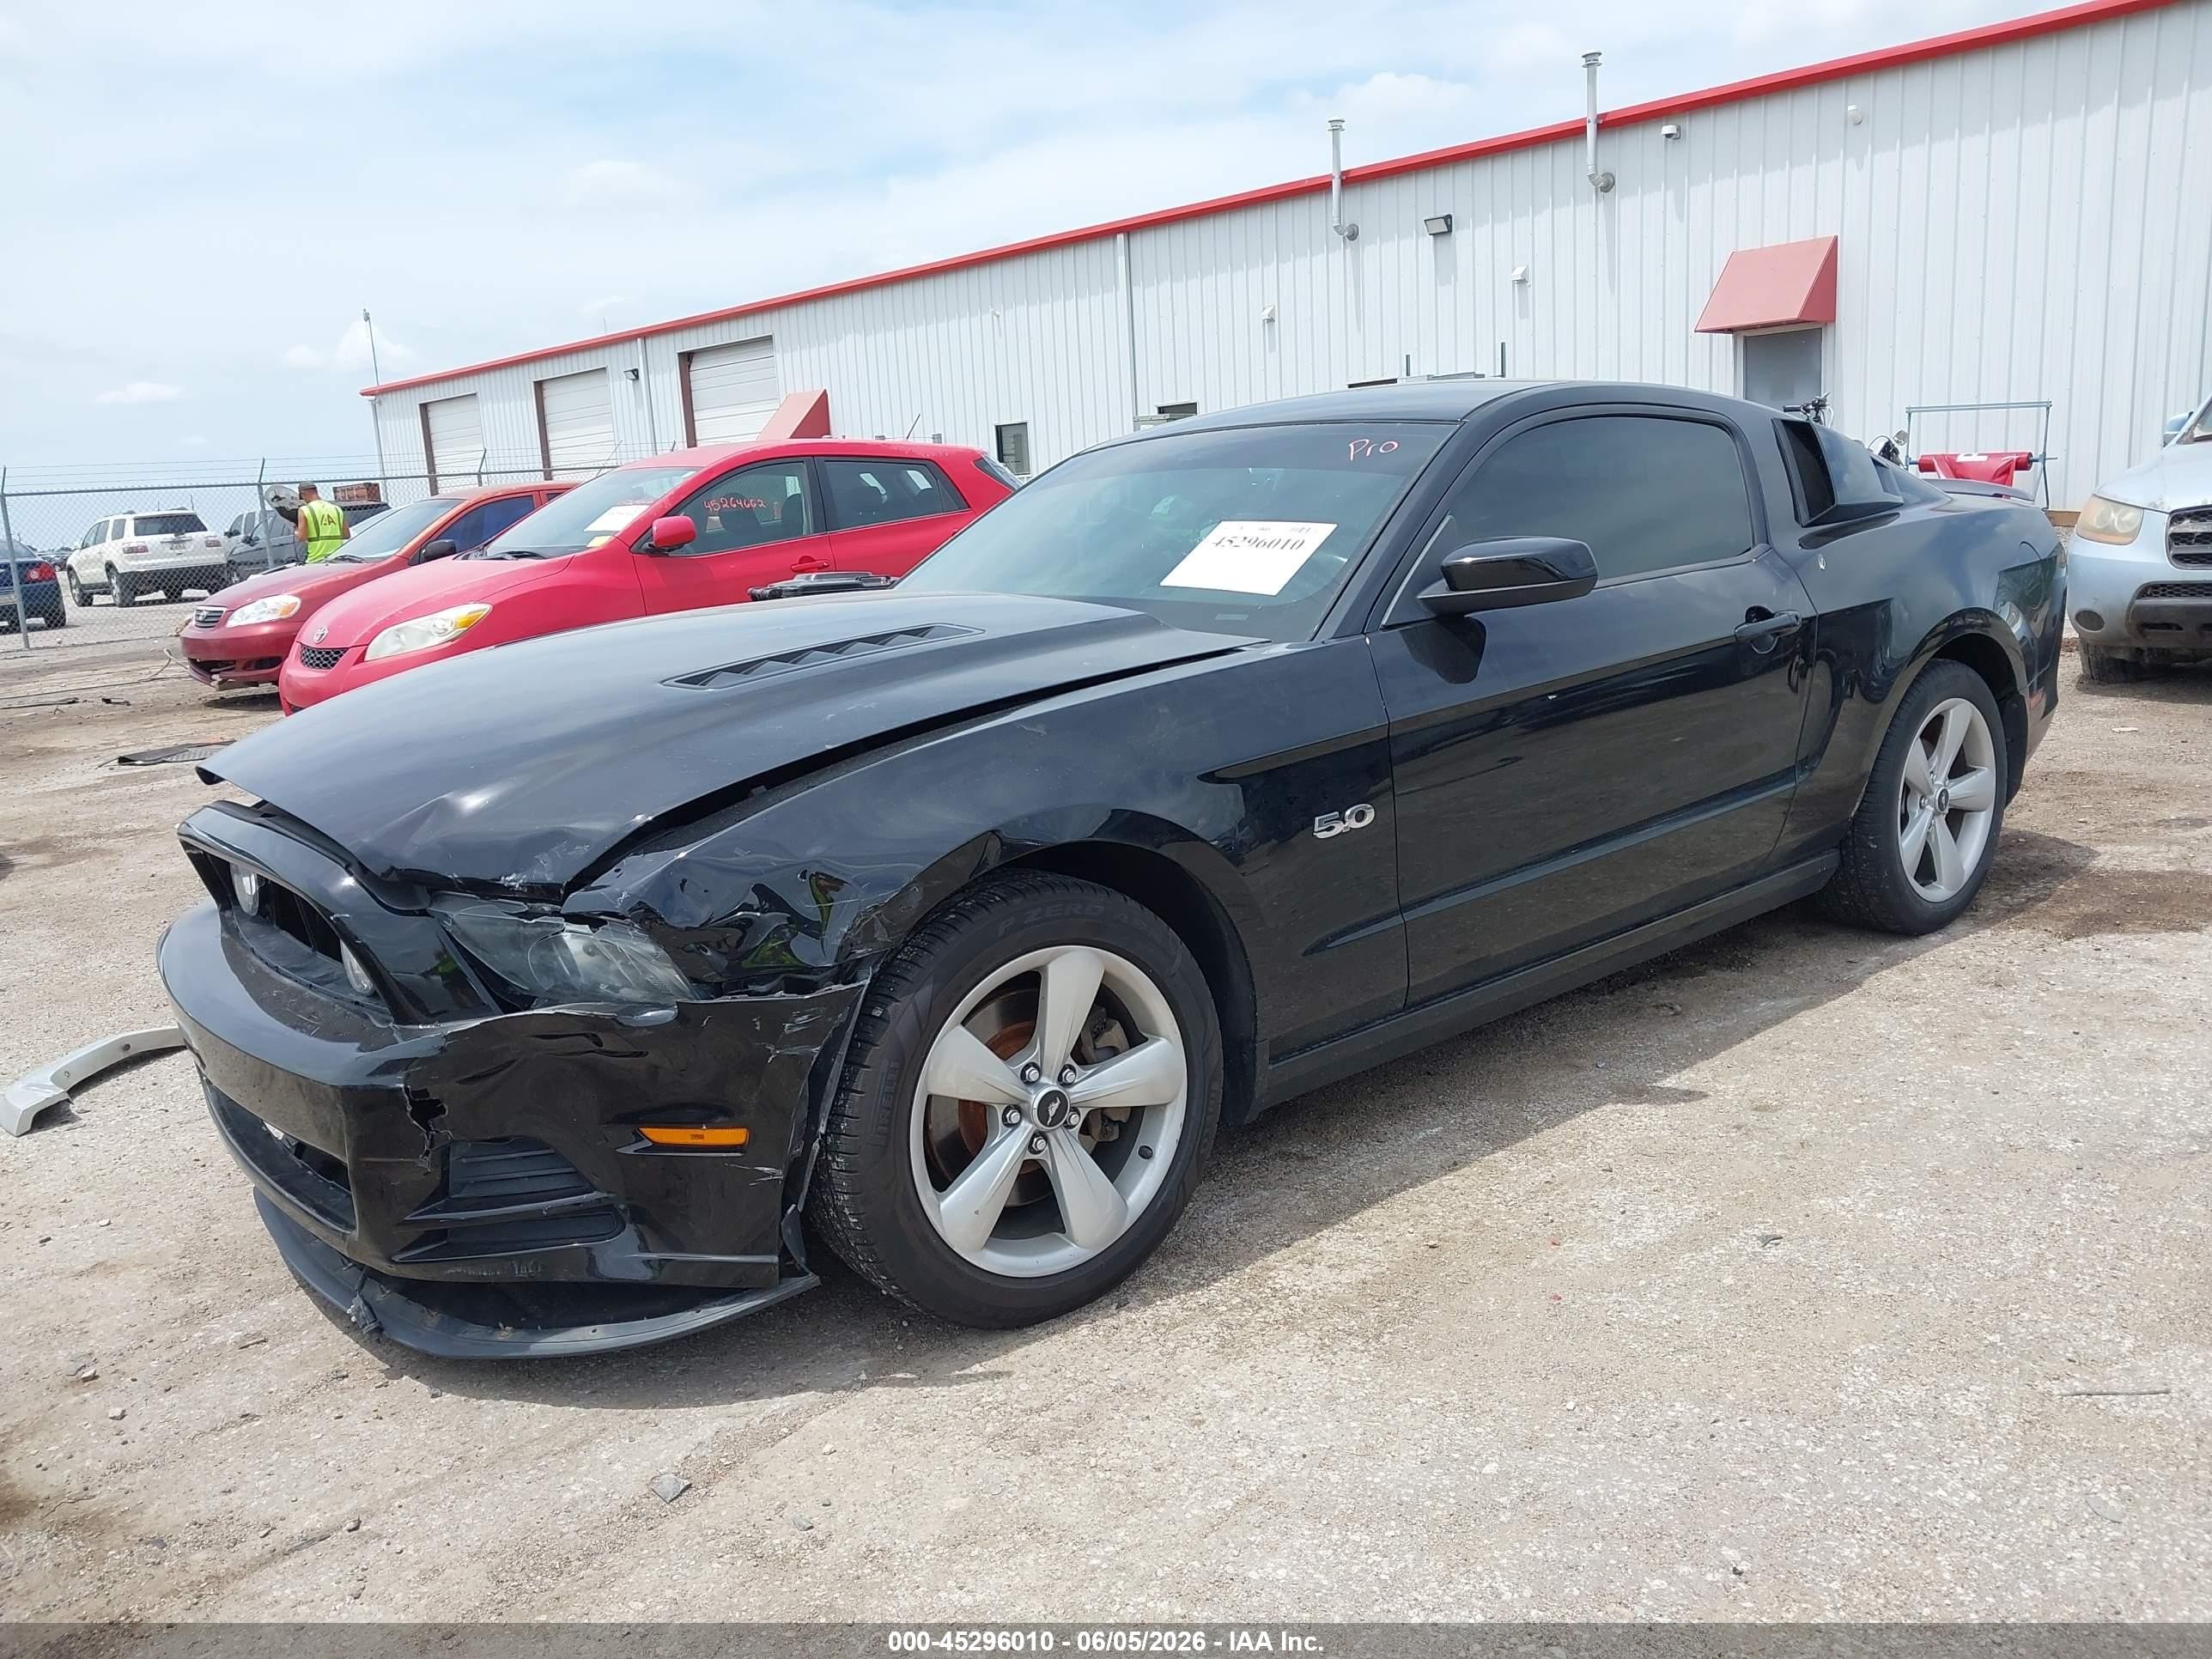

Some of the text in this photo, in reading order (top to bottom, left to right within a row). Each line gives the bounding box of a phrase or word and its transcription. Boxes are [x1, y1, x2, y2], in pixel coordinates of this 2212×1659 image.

[1349, 439, 1399, 461] Pro
[1313, 803, 1376, 839] 5.0
[1024, 902, 1105, 925] ZERO
